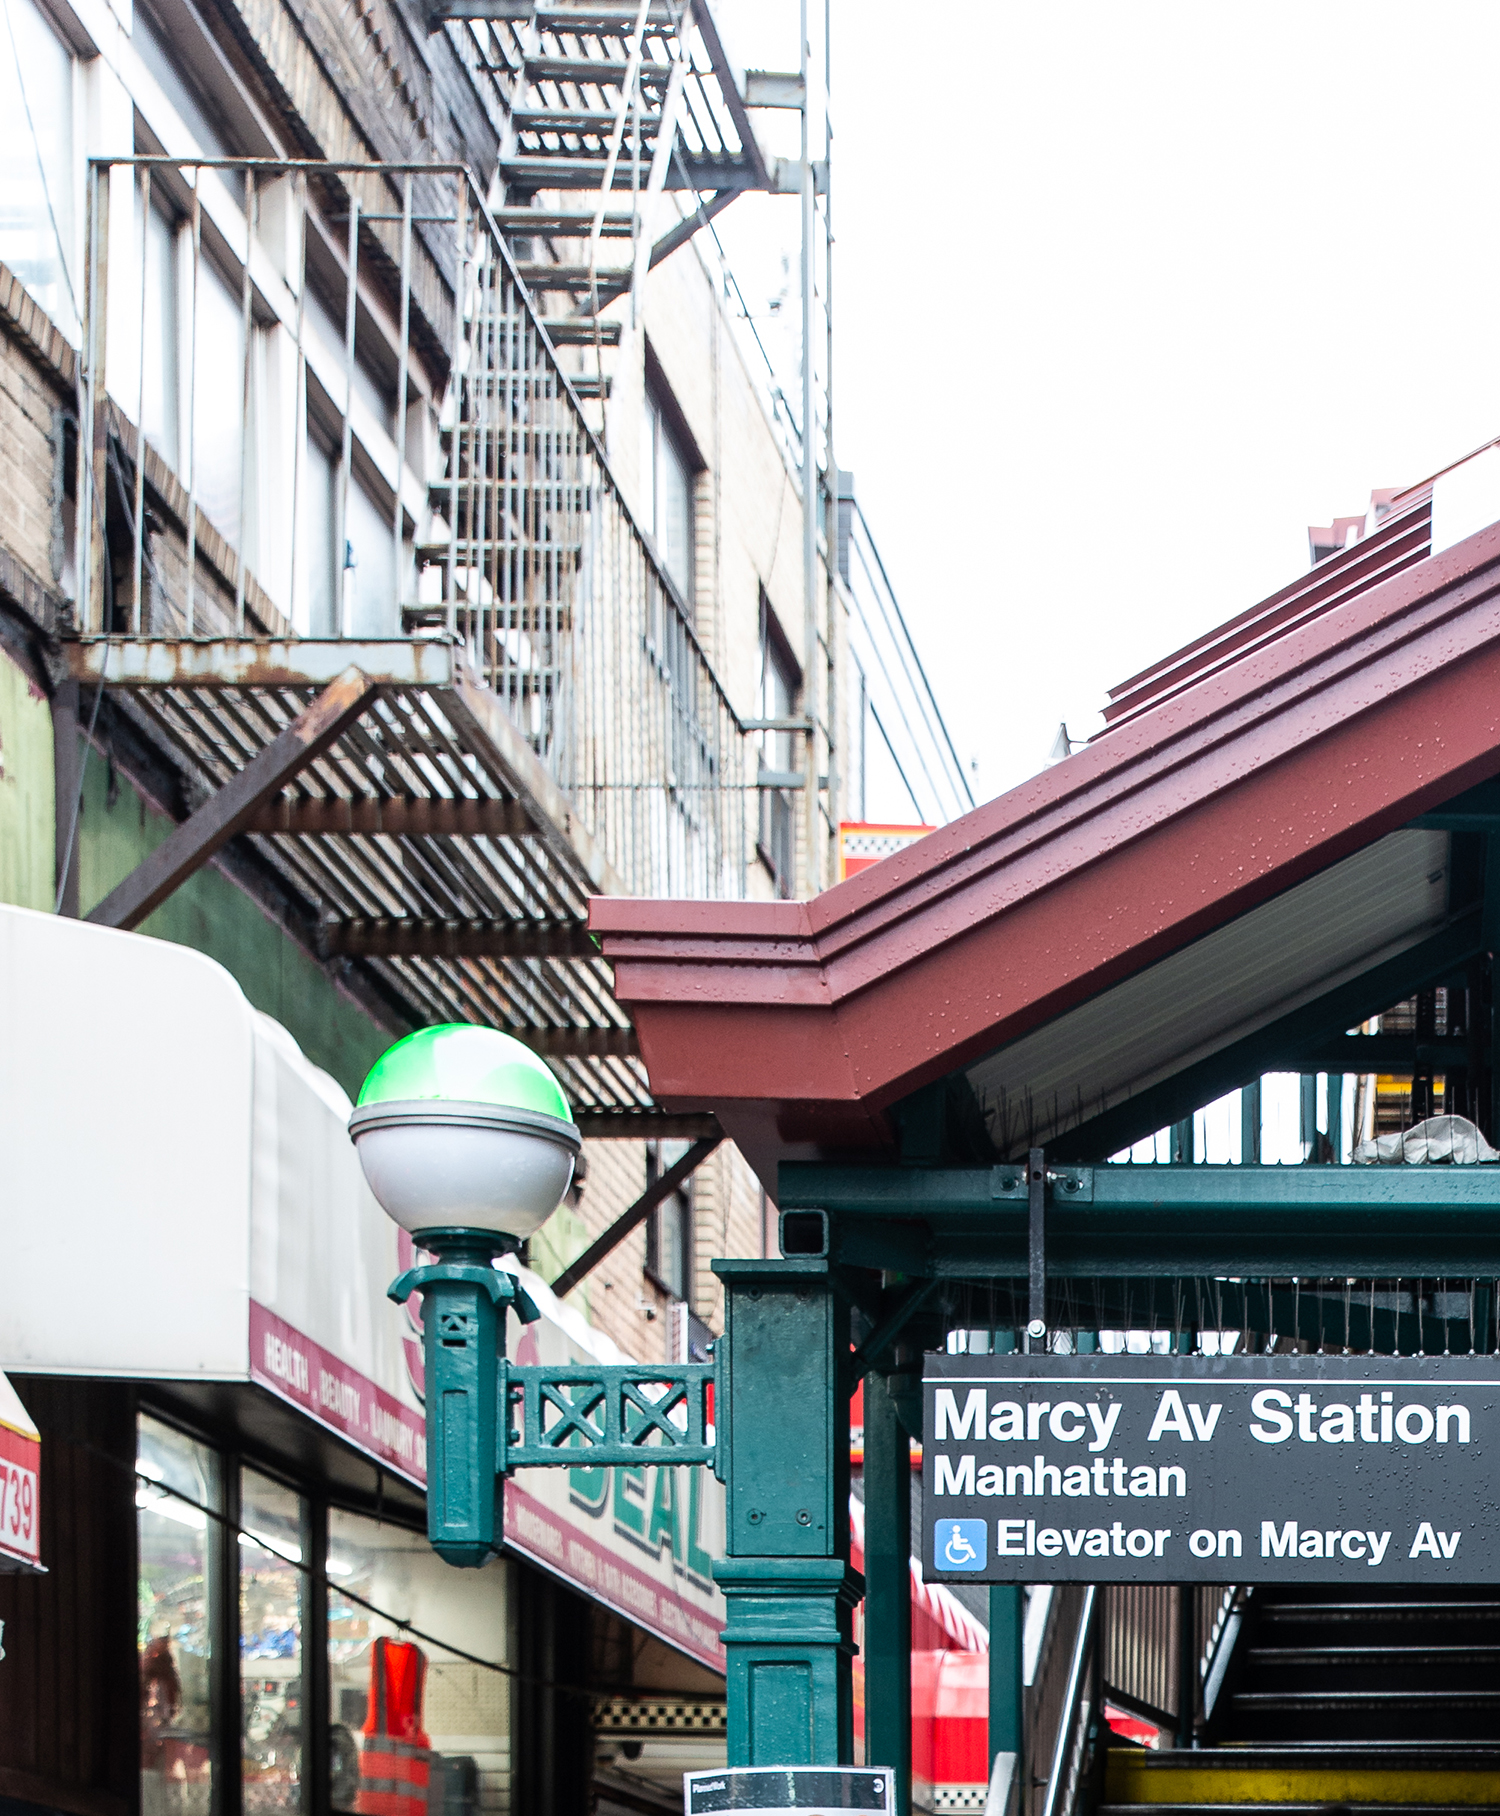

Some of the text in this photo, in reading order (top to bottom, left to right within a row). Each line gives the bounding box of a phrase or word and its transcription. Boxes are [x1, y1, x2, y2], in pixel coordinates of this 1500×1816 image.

[264, 1332, 308, 1394] HEALTH
[319, 1369, 360, 1426] BEAUTY
[933, 1387, 1471, 1452] Marcy Av Station
[933, 1455, 1187, 1498] Manhattan
[997, 1519, 1461, 1567] Elevator on Marcy Av
